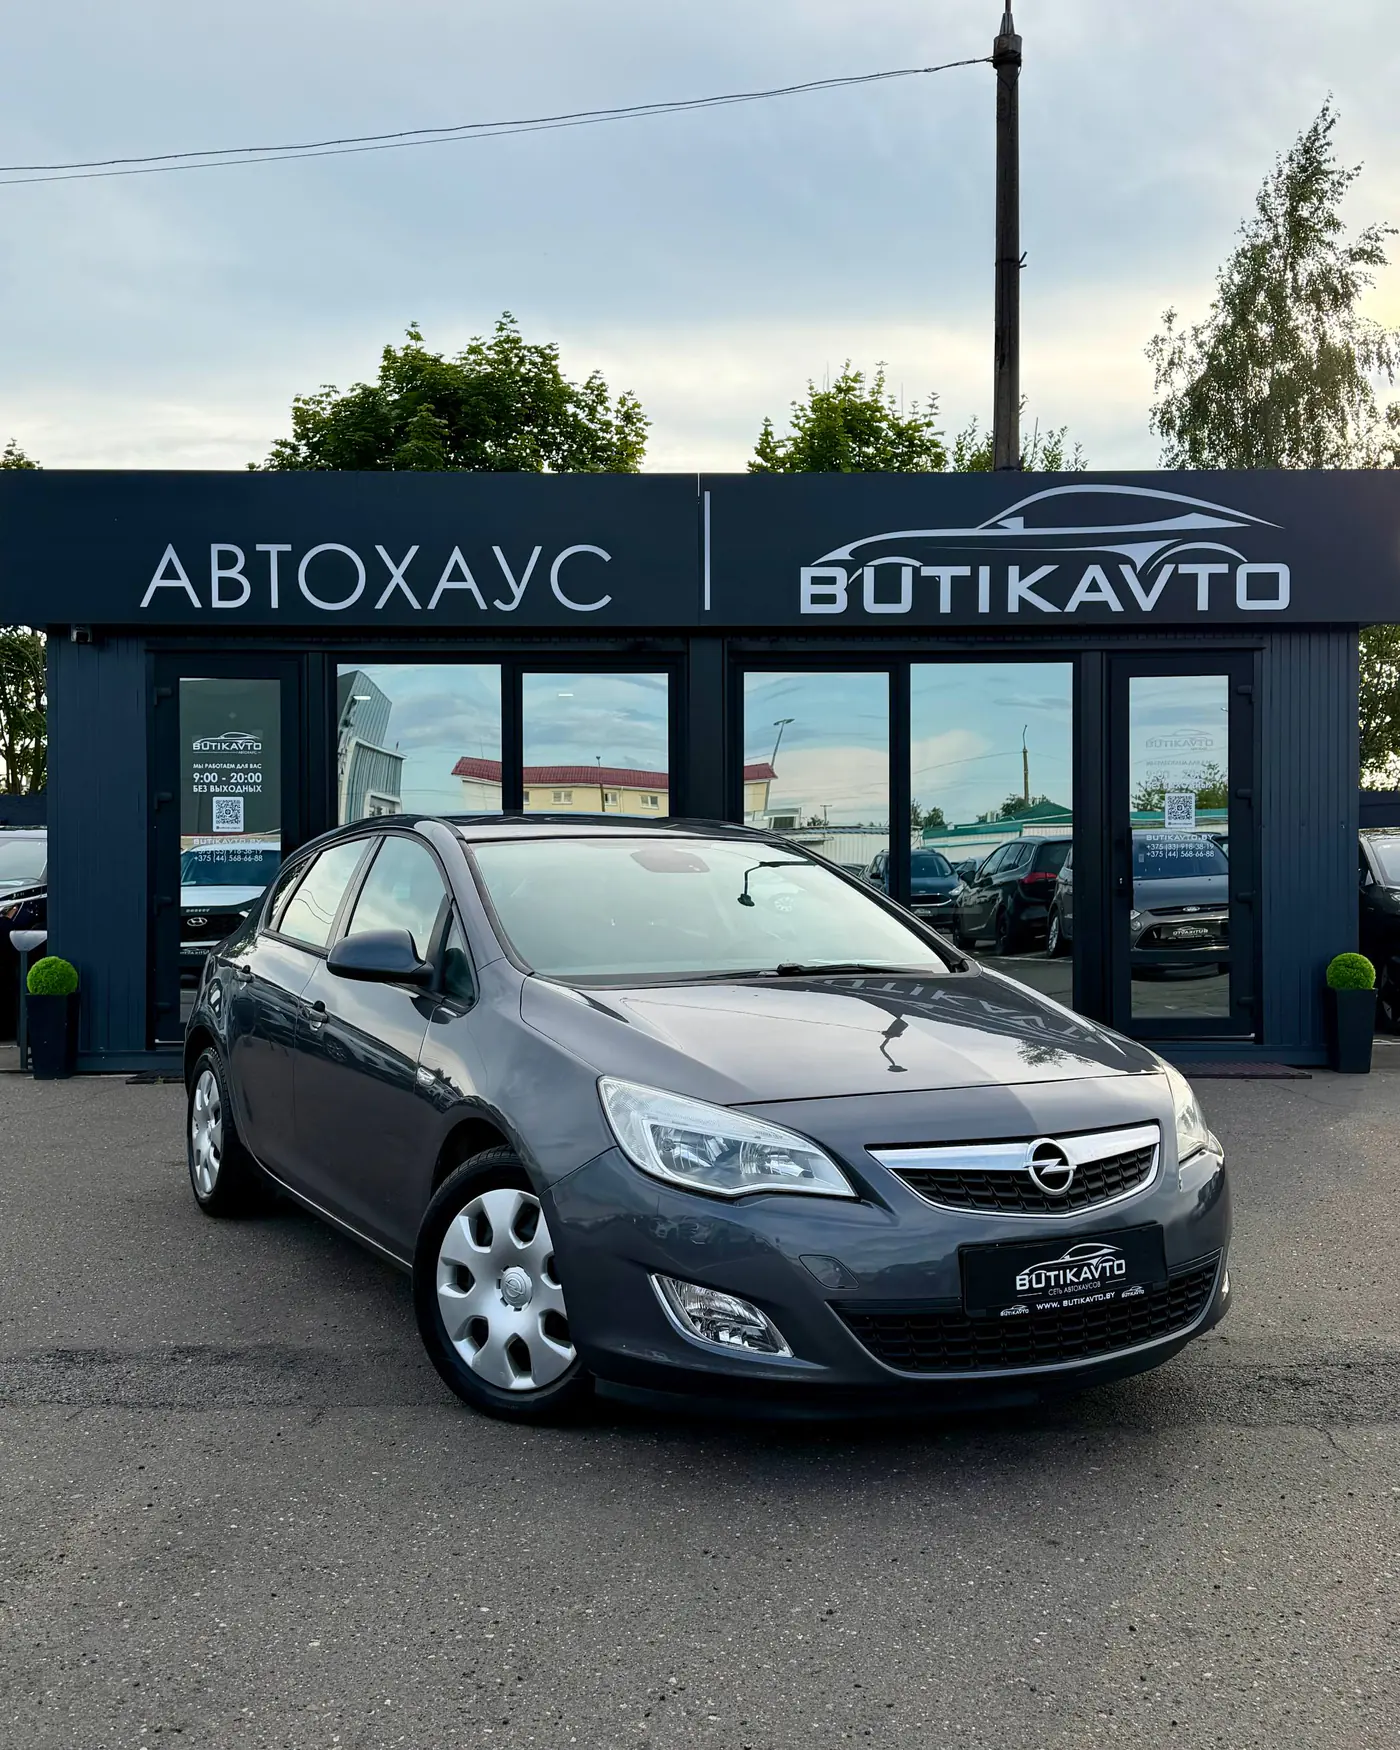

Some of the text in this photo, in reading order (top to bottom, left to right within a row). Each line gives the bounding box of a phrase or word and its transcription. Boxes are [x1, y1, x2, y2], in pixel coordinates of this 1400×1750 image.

[140, 543, 612, 612] АВТОХАУС
[800, 562, 1291, 614] BUTIKAVTO
[193, 742, 262, 751] BUTIKAVTO
[193, 773, 218, 783] 9:00
[230, 773, 262, 783] 20:00
[193, 785, 262, 793] БЕЗ ВЫХОДНЫХ
[1165, 843, 1179, 851] (33)
[213, 855, 227, 863] (44)
[1165, 850, 1179, 859] (44)
[1016, 1260, 1126, 1290] BUTIKAVTO
[1048, 1281, 1101, 1296] СЕТЬ АВТОХАУСОВ
[1036, 1291, 1116, 1310] WWW. BUTIKAVTO.BY
